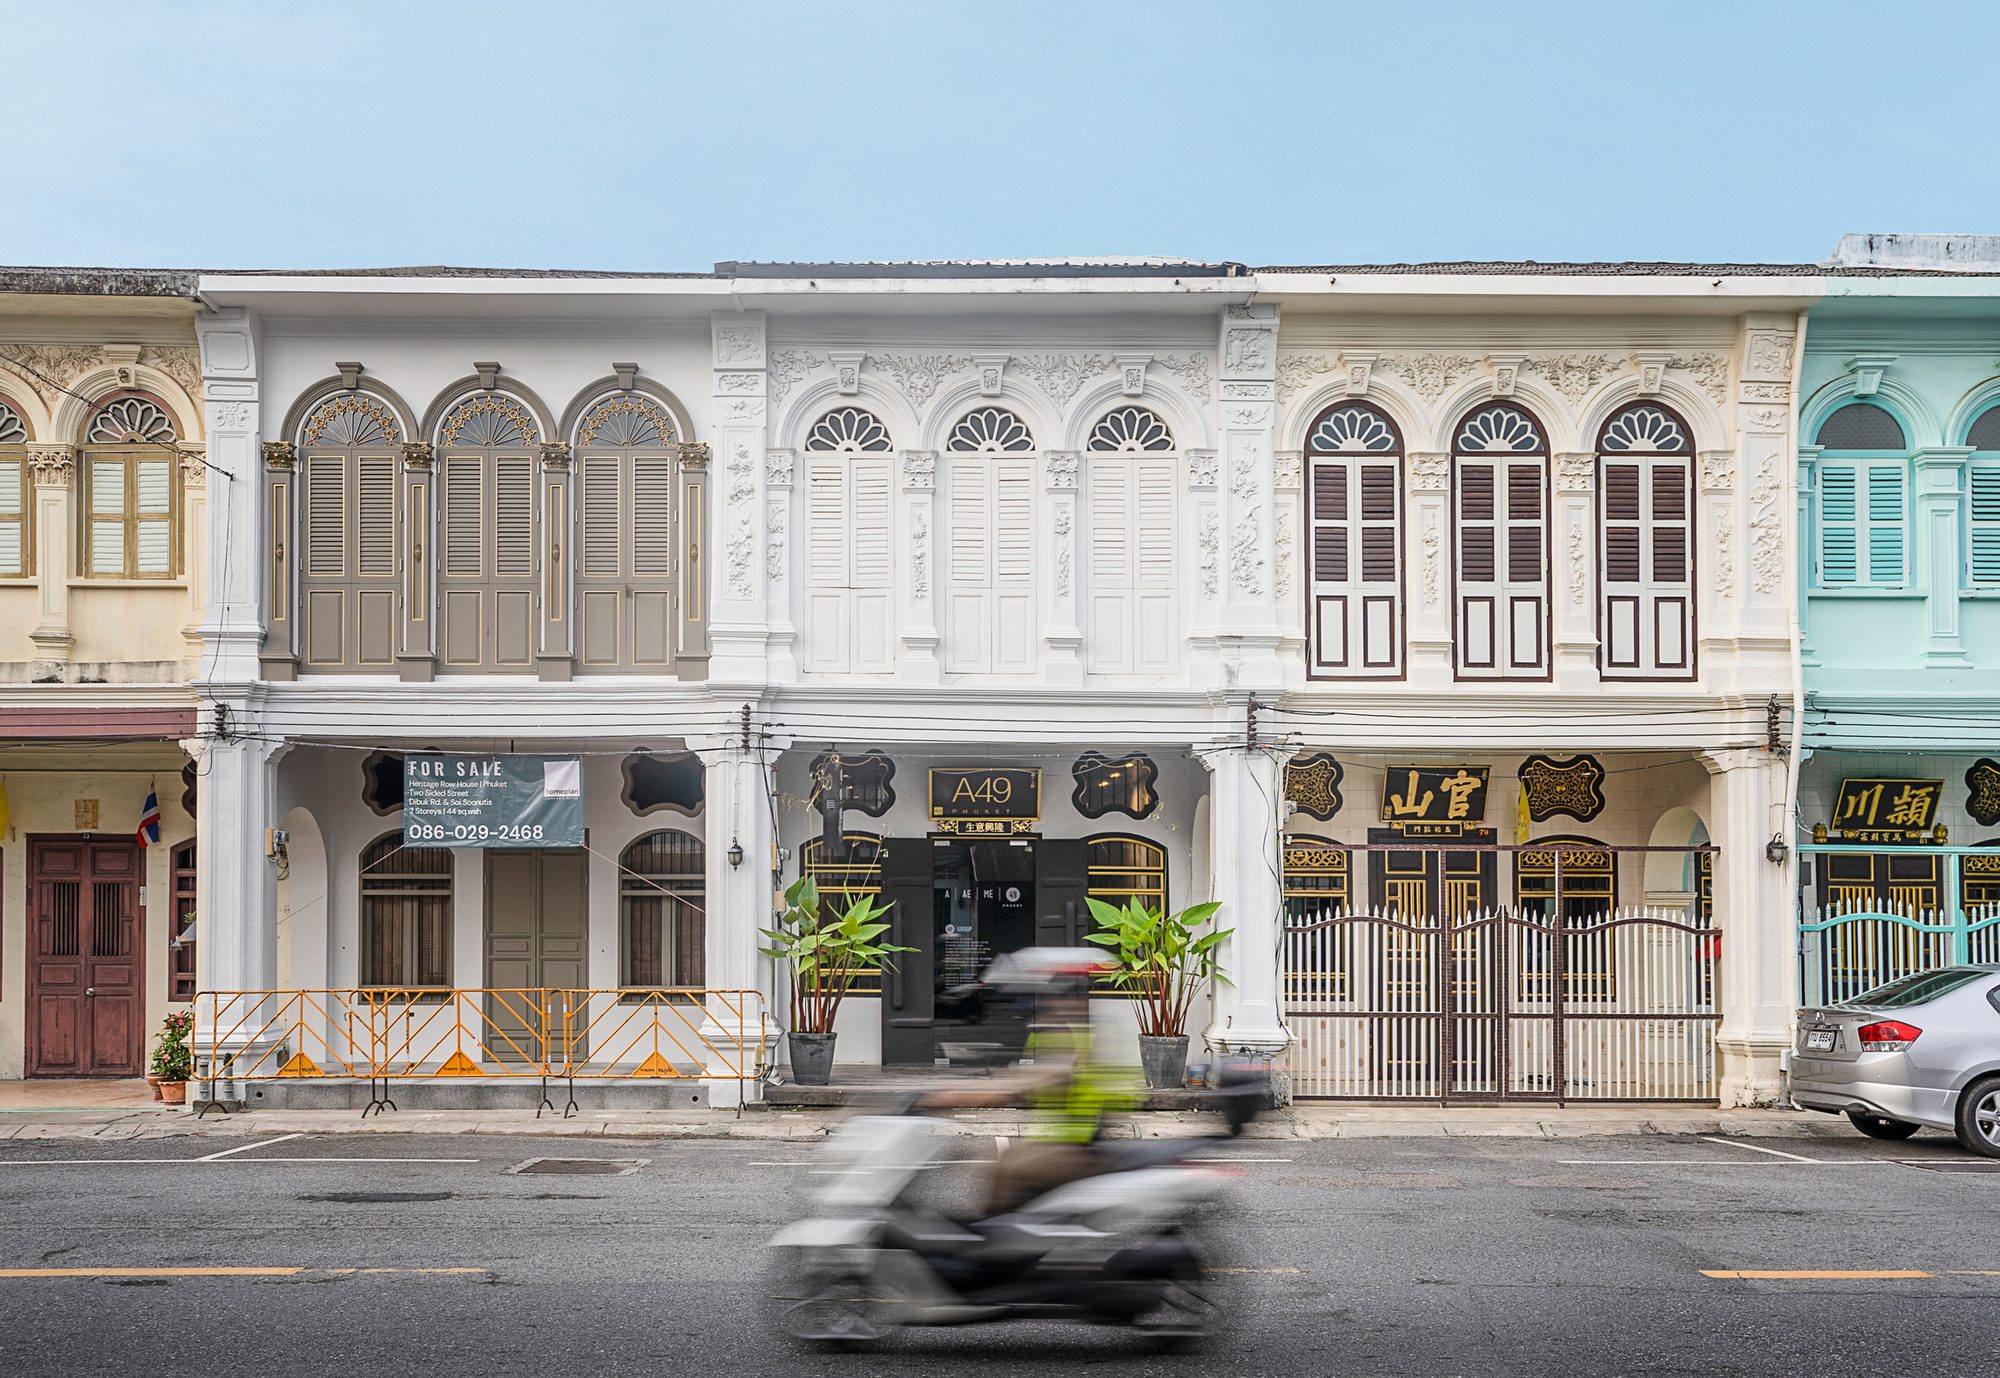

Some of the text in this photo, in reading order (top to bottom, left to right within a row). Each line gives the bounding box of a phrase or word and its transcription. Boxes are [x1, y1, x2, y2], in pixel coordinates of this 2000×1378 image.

[409, 760, 502, 777] FOR SALE
[409, 780, 507, 789] Heritage Row House Phuket
[425, 789, 446, 797] Sided
[447, 789, 469, 797] Street
[545, 788, 579, 796] homeplan
[951, 777, 1012, 803] A49
[409, 798, 429, 806] Dibuk
[450, 798, 462, 806] Soi
[409, 807, 414, 815] 2
[415, 807, 442, 816] Storeys
[446, 807, 457, 815] 44
[409, 824, 544, 840] 086-029-2468
[944, 889, 950, 899] A
[962, 889, 972, 899] AE
[983, 889, 994, 899] ME
